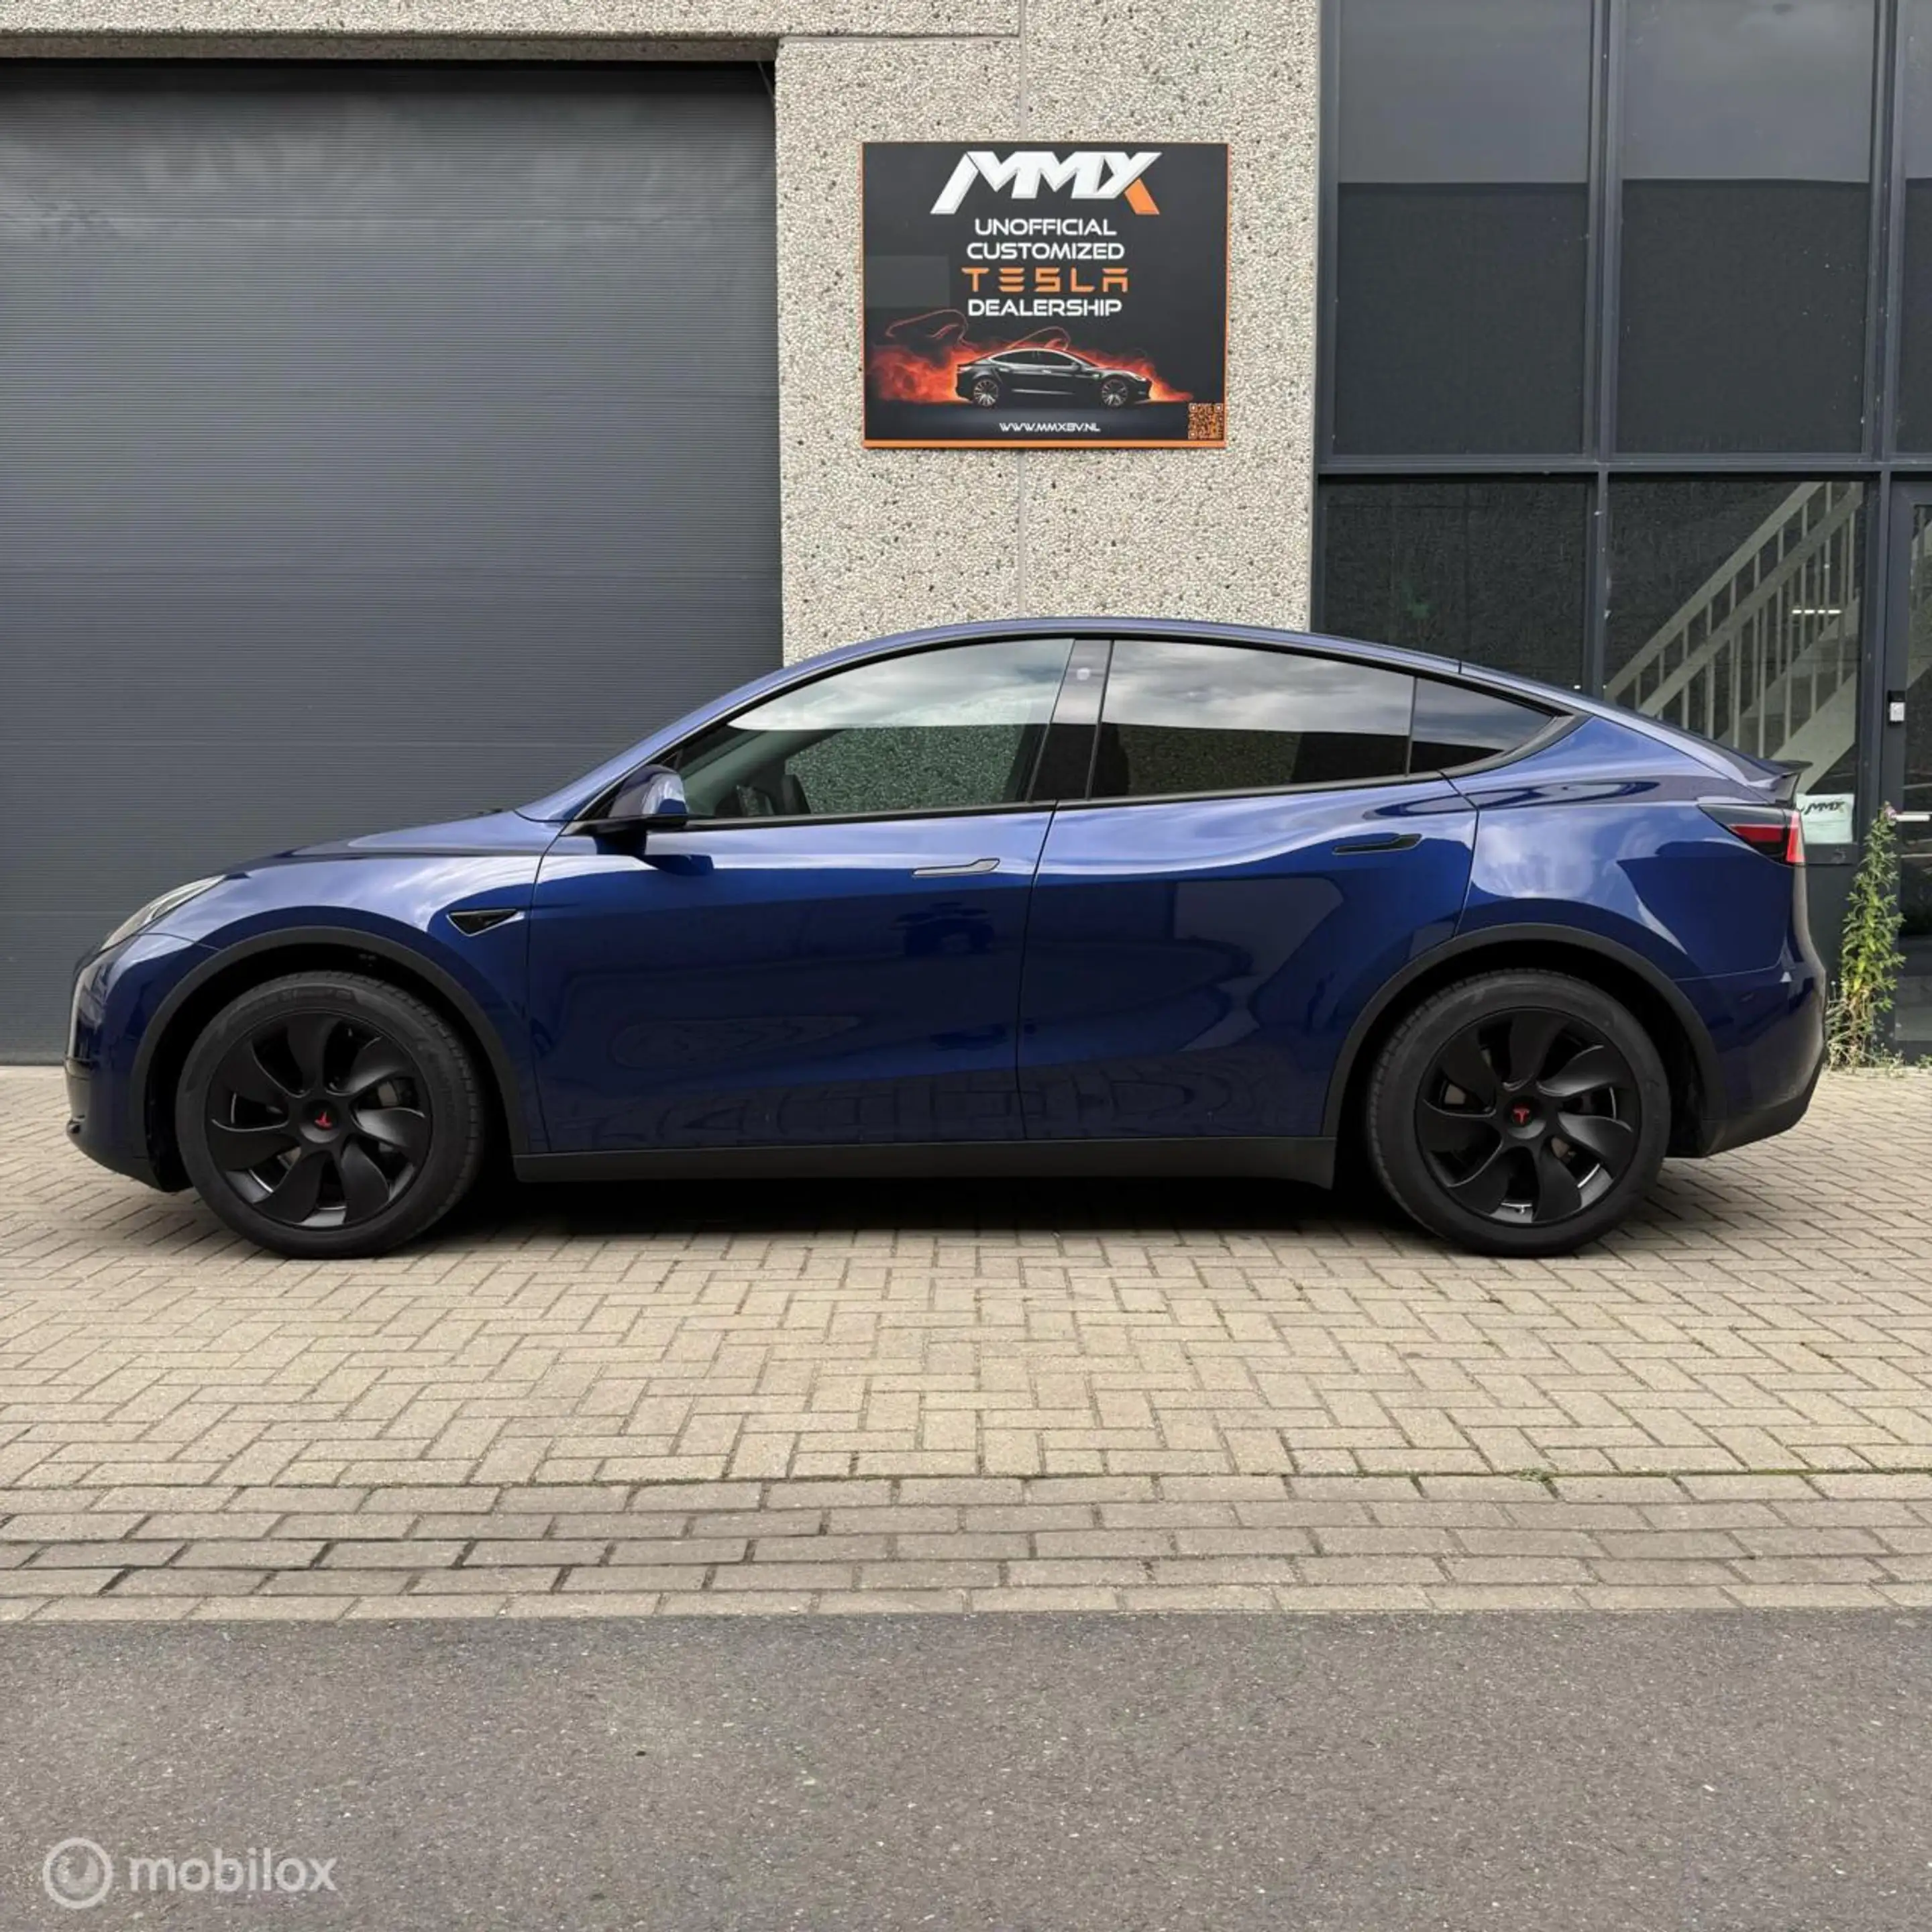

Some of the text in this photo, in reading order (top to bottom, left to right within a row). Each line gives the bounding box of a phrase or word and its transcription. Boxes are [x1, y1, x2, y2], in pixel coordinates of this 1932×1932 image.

[930, 151, 1163, 215] MMX
[975, 218, 1118, 236] UNOFFICIAL
[966, 242, 1125, 260] CUSTOMIZED
[961, 267, 1128, 292] TESLA
[967, 299, 1122, 317] DEALERSHIP
[998, 422, 1102, 433] WWW.MMXBV.NL
